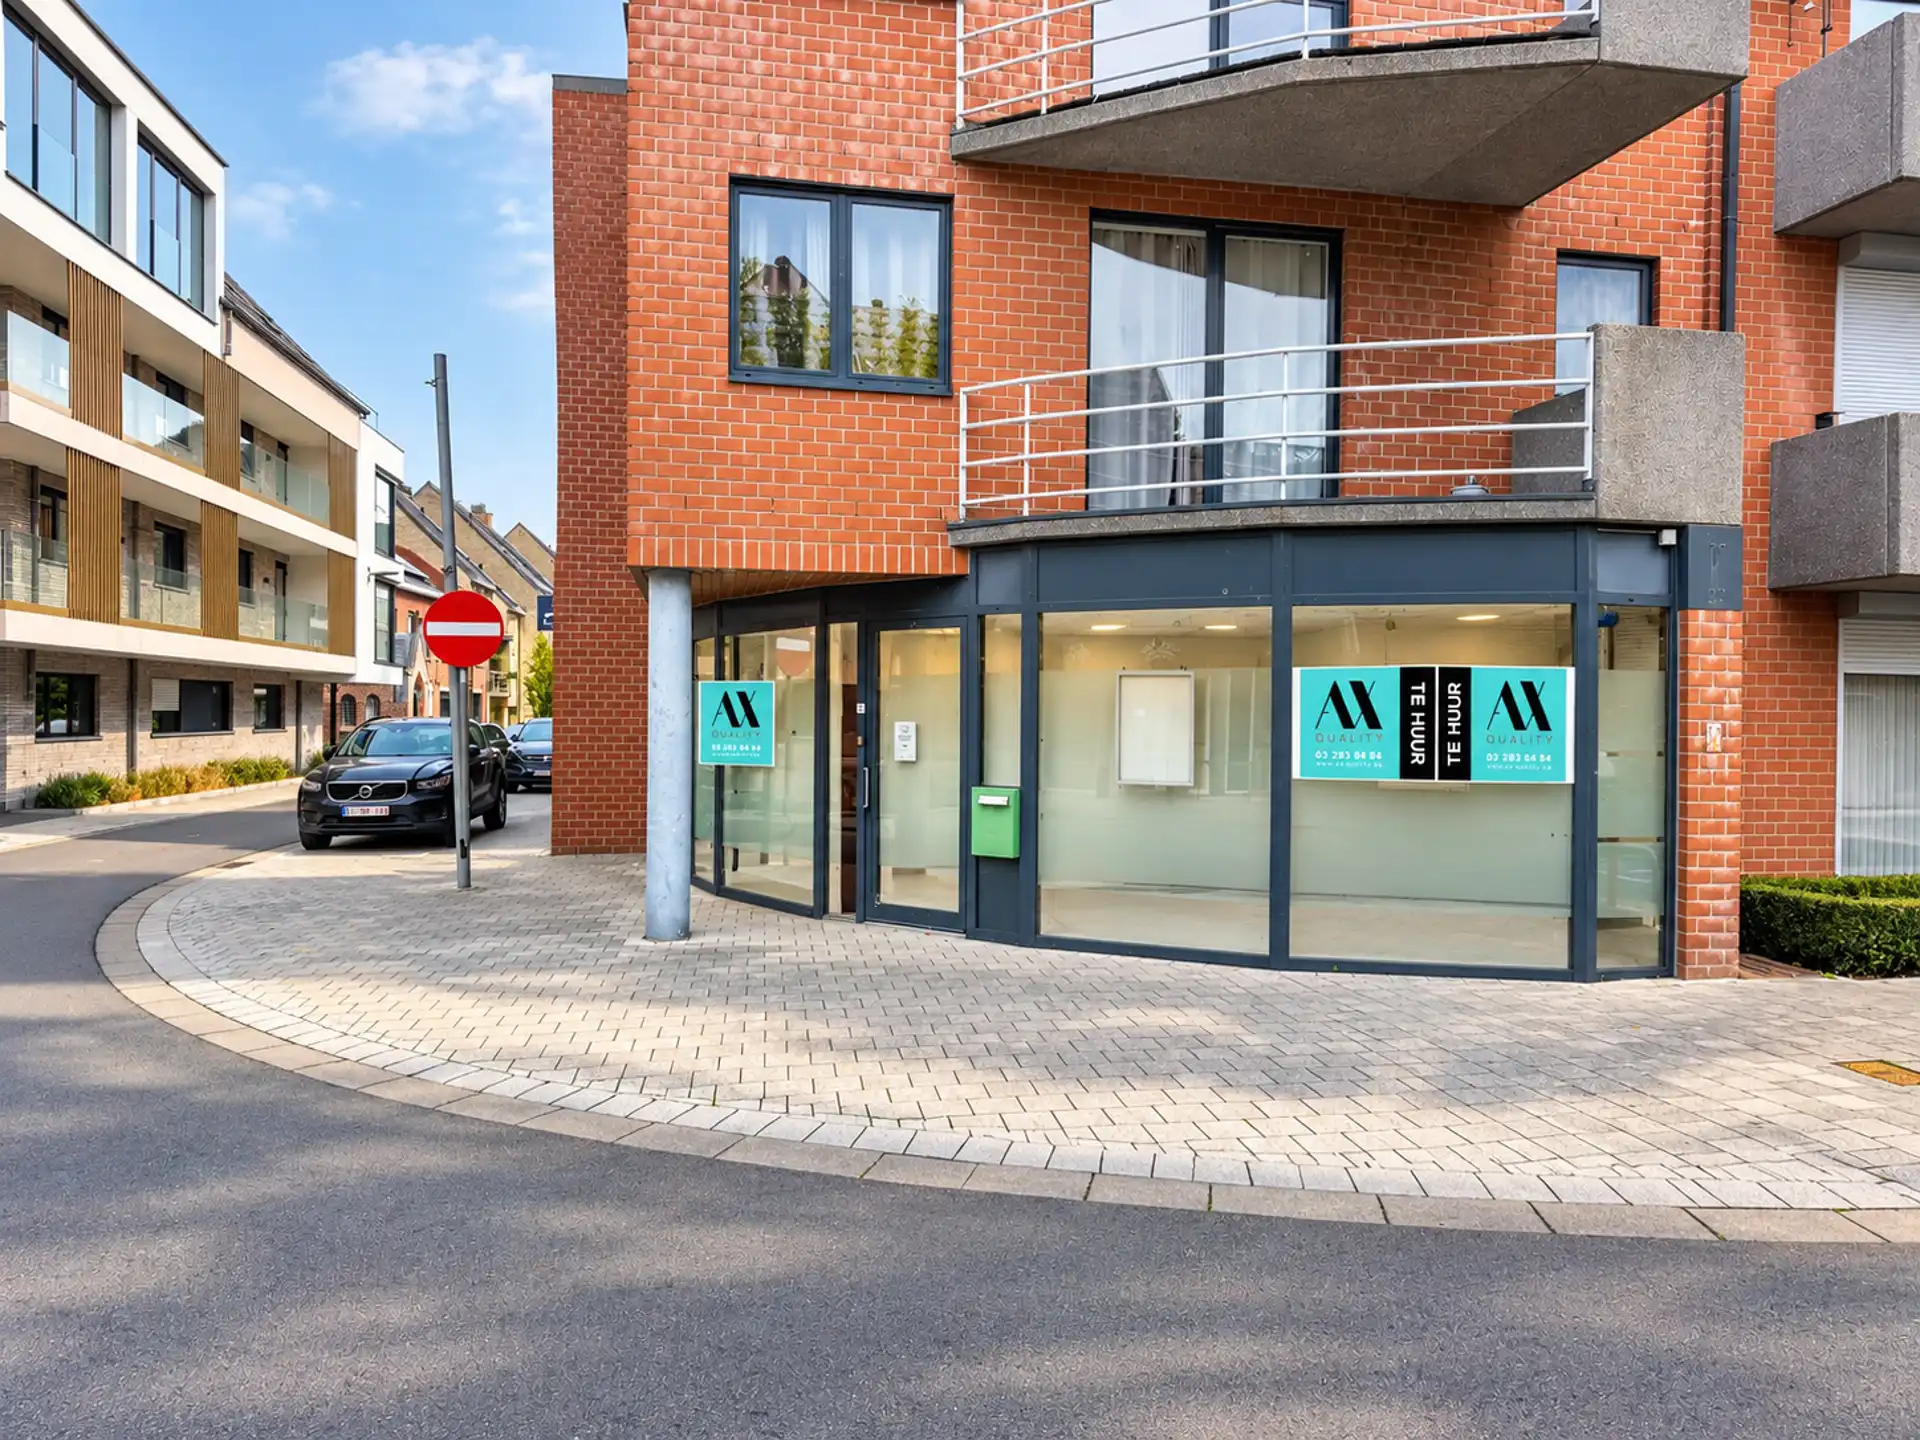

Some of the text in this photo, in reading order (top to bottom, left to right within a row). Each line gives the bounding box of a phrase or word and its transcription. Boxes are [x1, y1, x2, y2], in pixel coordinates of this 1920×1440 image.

[1314, 680, 1383, 730] AX
[1410, 682, 1426, 765] TE HUUR
[1447, 682, 1462, 767] TE HUUR
[1486, 680, 1552, 731] AX
[1315, 733, 1383, 743] QUALITY
[1486, 735, 1552, 745] QUALITY
